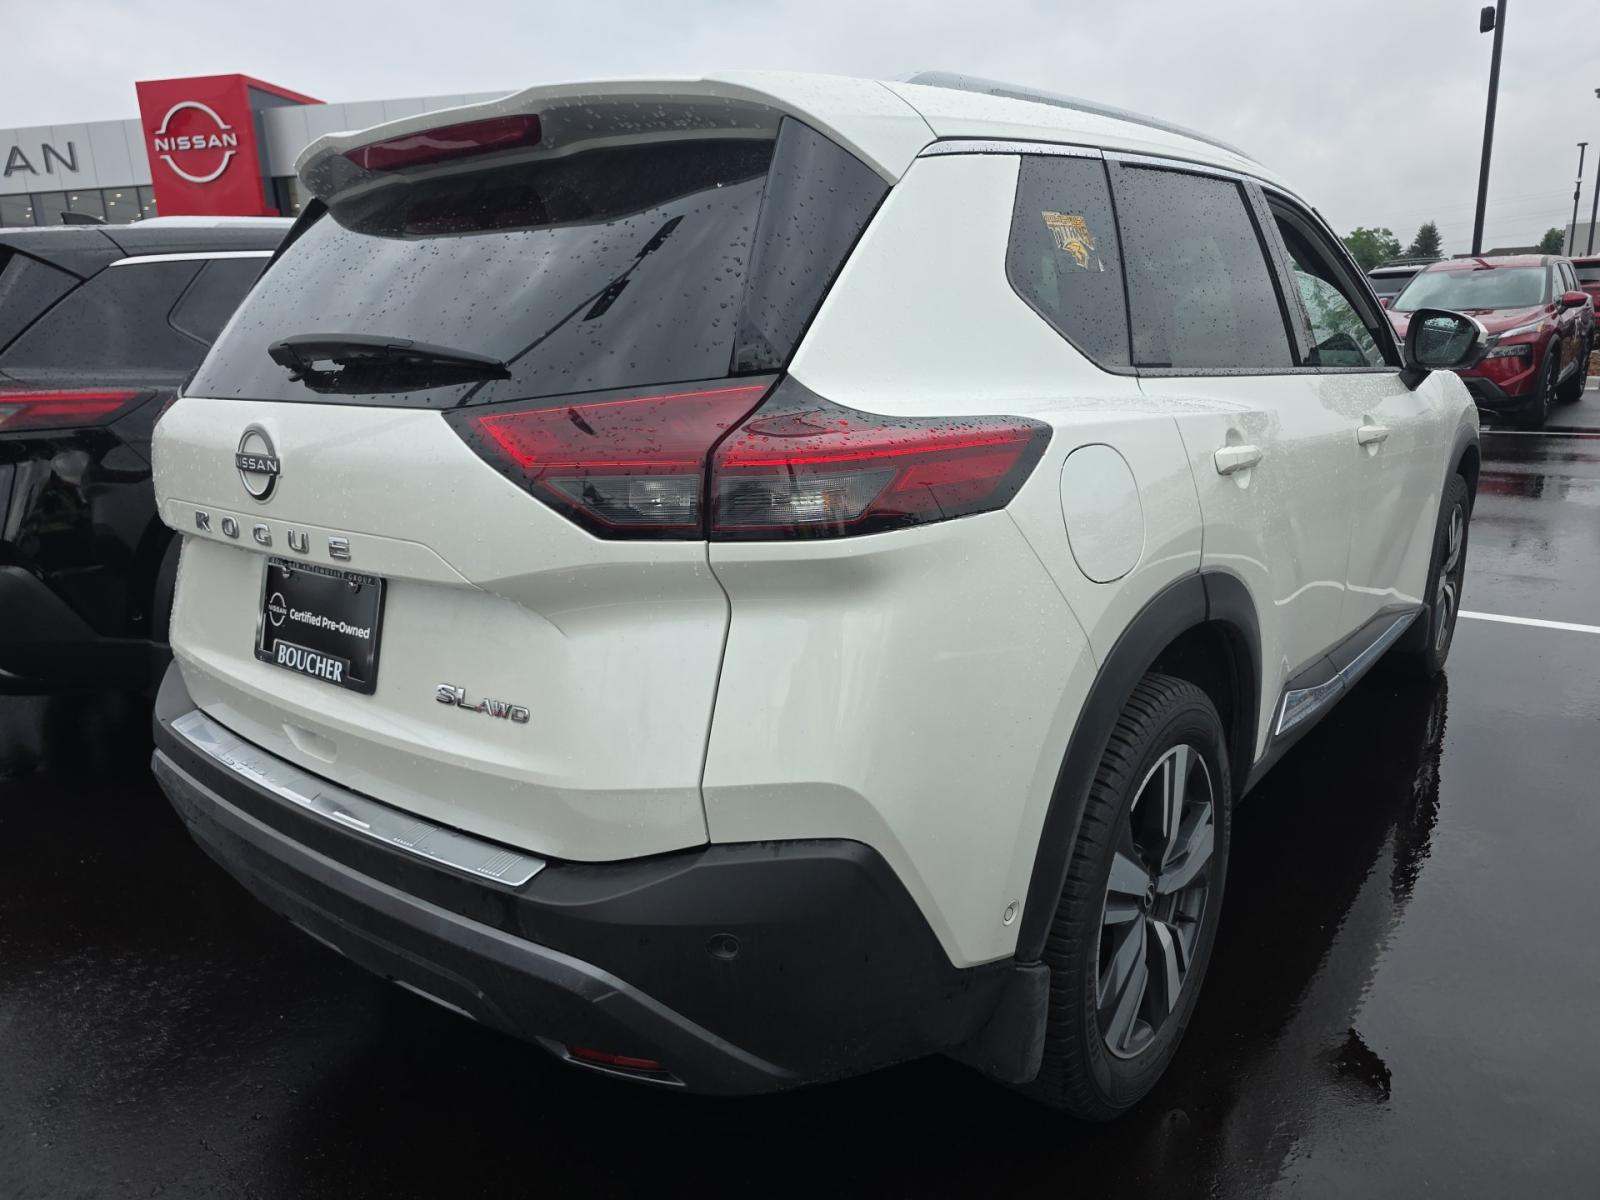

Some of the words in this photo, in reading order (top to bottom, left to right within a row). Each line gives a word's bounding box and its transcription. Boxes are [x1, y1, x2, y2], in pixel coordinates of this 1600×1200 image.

[3, 141, 79, 177] AN
[154, 133, 237, 151] NISSAN
[195, 511, 351, 561] ROGUE
[289, 608, 321, 627] Certified
[322, 616, 371, 639] Pre-Owned
[277, 644, 343, 682] BOUCHER
